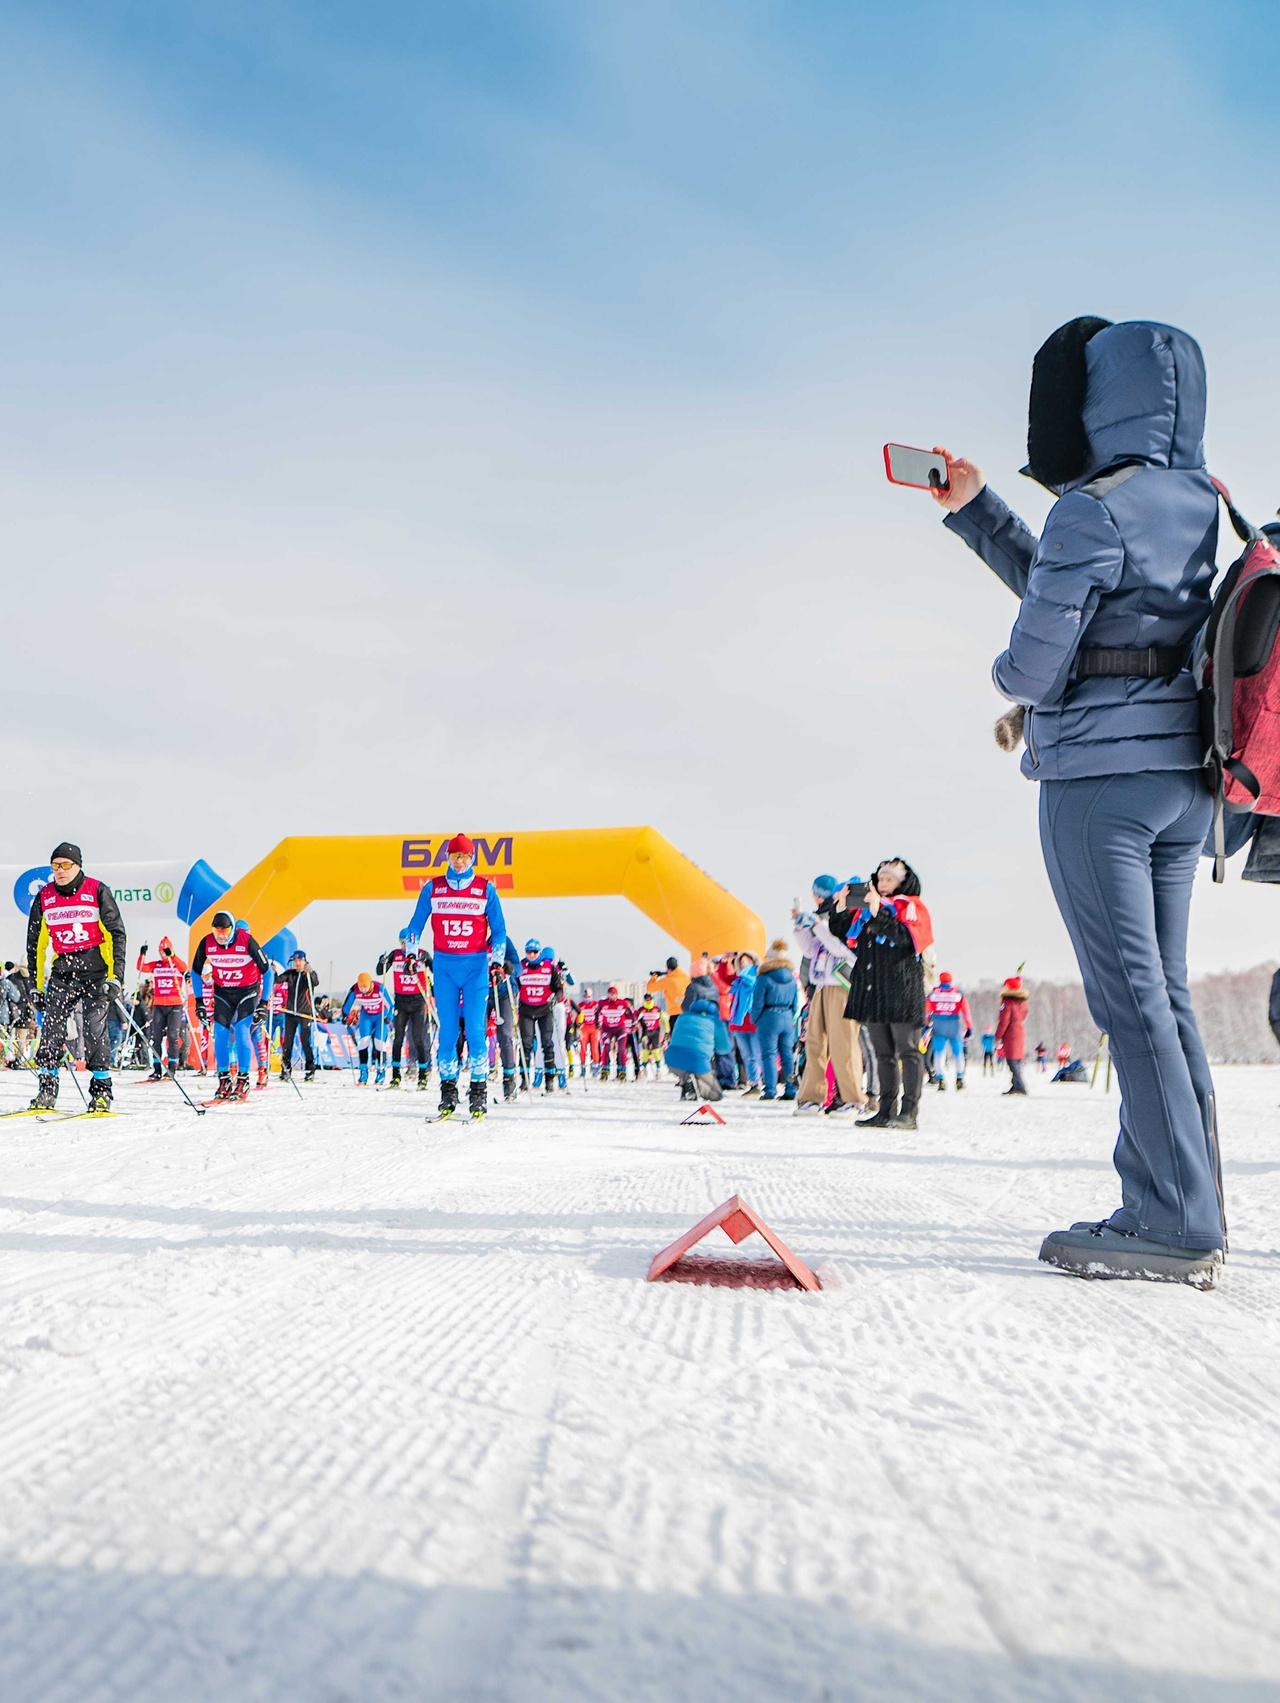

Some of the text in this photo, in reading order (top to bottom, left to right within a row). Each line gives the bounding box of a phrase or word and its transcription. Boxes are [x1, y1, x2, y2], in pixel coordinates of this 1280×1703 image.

[114, 888, 152, 902] лата
[442, 920, 474, 936] 135
[217, 969, 243, 980] 173
[157, 979, 174, 988] 152
[526, 986, 545, 996] 113
